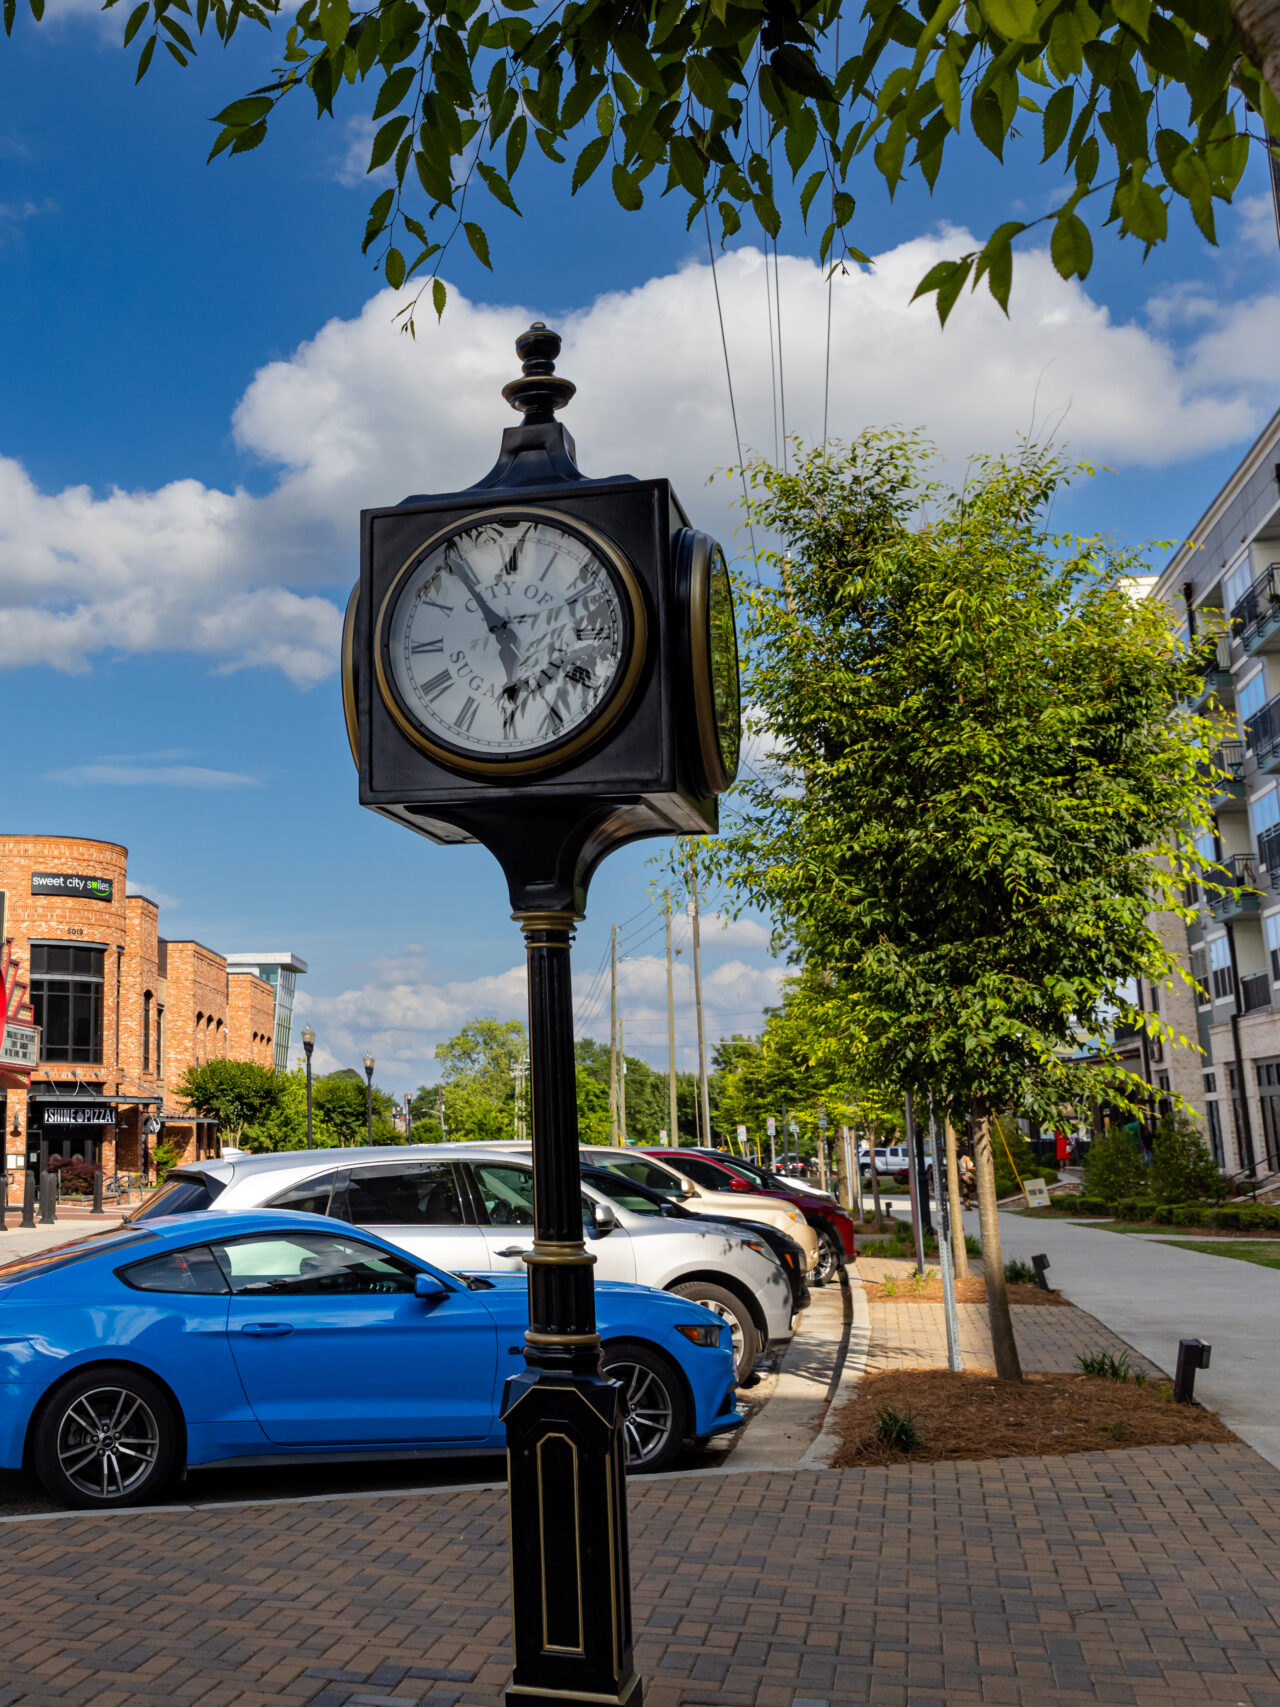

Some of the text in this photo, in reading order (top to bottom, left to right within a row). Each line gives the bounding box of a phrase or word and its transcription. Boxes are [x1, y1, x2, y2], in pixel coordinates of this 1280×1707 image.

[464, 580, 554, 614] CTY OF
[449, 650, 516, 702] SUGA
[32, 876, 110, 891] sweet city smiles
[48, 1108, 111, 1123] SHINE PIZZA
